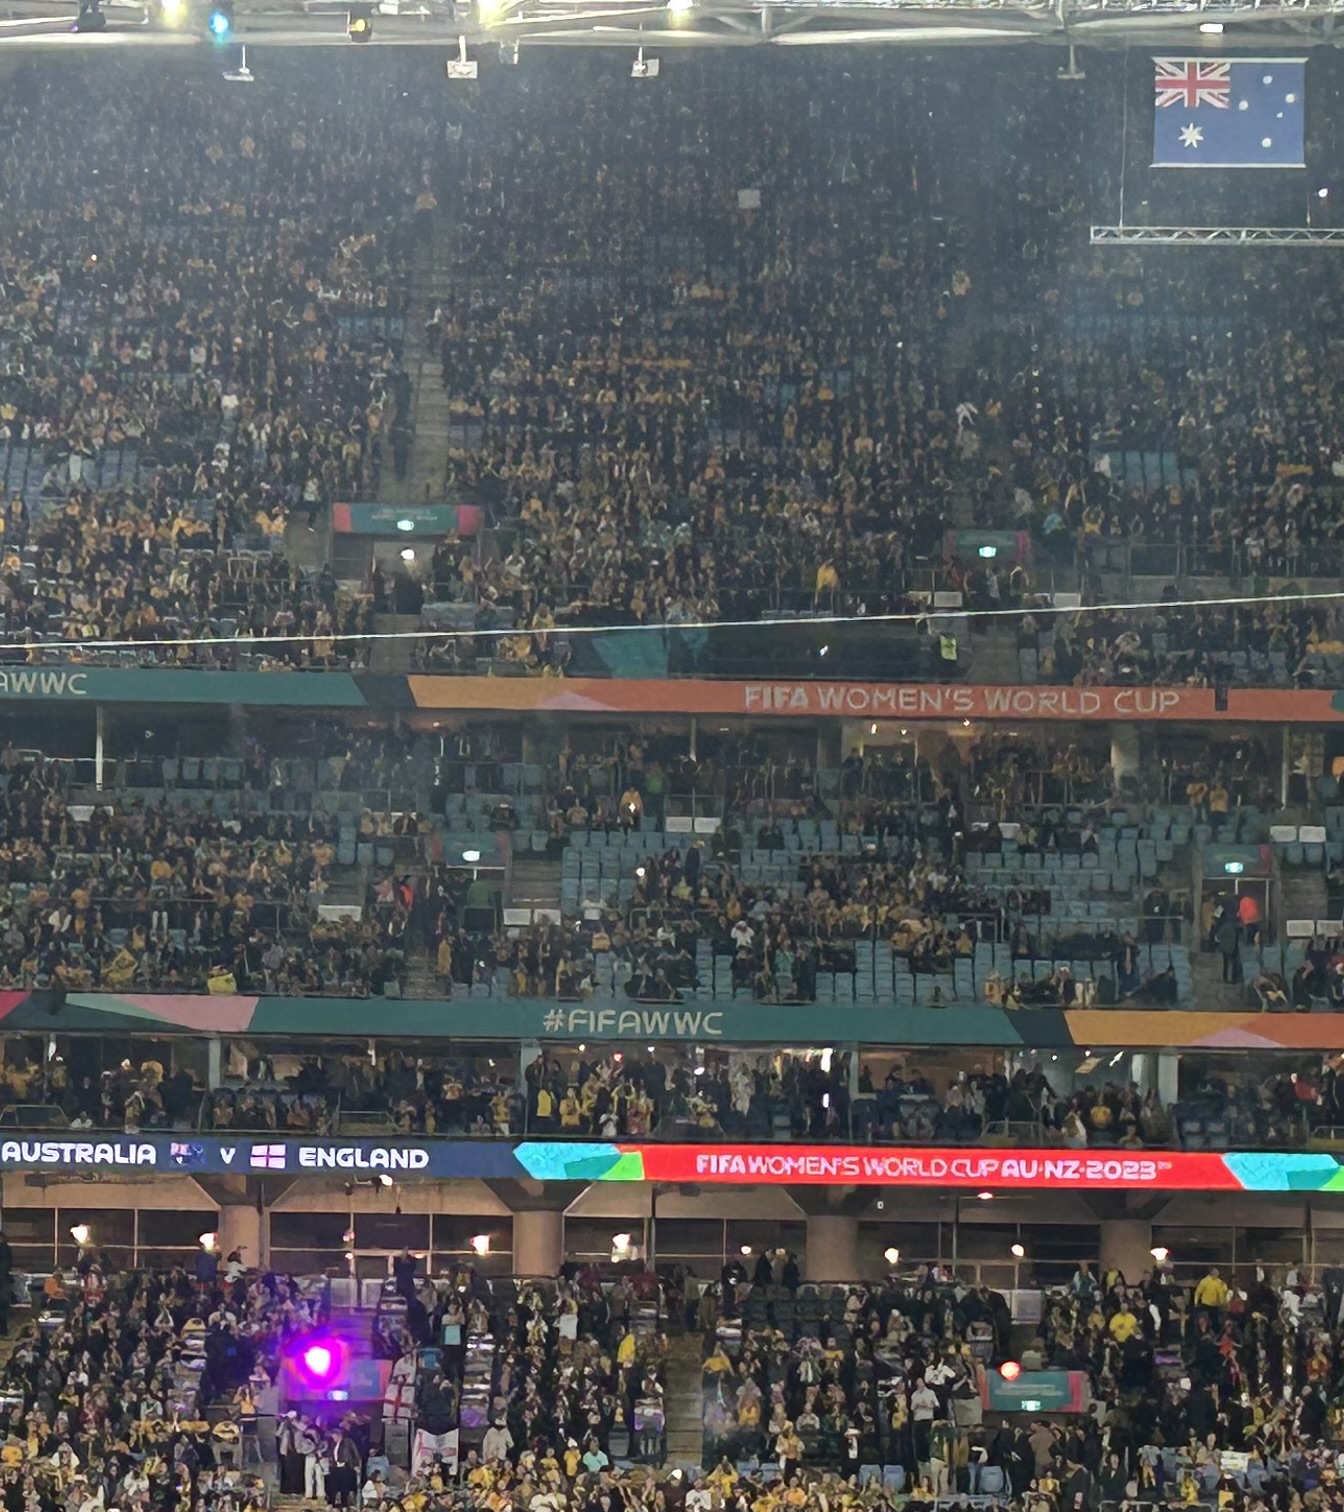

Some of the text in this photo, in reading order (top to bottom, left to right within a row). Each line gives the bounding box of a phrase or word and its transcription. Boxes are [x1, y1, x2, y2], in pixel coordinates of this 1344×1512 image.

[745, 685, 1181, 714] FIFA WOMEN'S WORLD CUP
[543, 1008, 723, 1035] #FIFAWWC
[1, 1140, 157, 1165] AUSTRALIA
[298, 1146, 429, 1169] ENGLAND
[696, 1153, 746, 1174] FIFA
[747, 1154, 860, 1176] WOMEN'S
[863, 1156, 948, 1177] WORLD
[950, 1158, 1000, 1179] CUP
